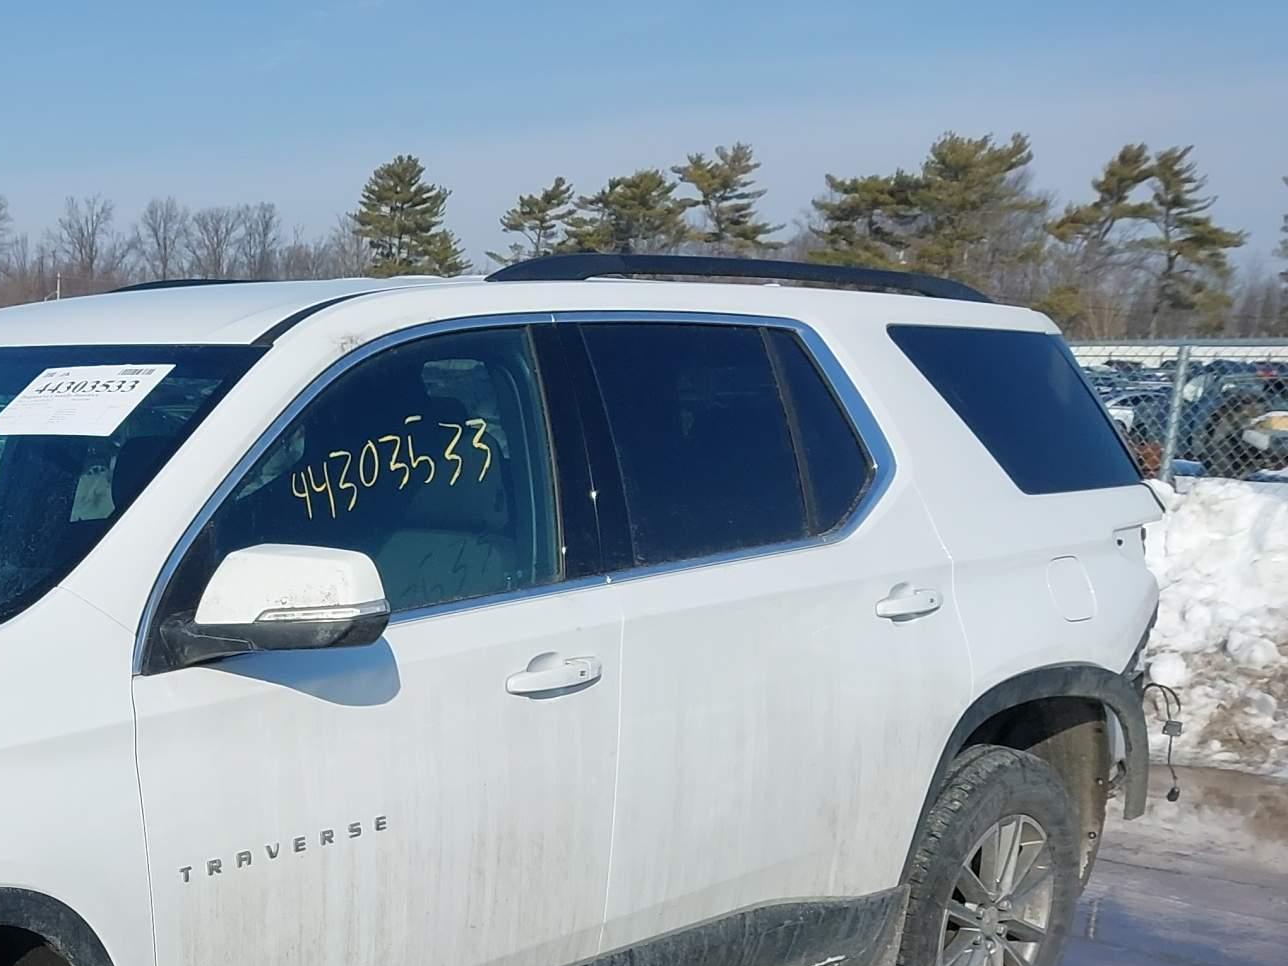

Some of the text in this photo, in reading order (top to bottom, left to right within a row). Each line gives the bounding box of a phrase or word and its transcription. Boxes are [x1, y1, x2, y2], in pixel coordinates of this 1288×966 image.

[35, 380, 140, 395] 44303533
[292, 415, 492, 520] 44303533
[179, 816, 388, 883] TRAVERSE
